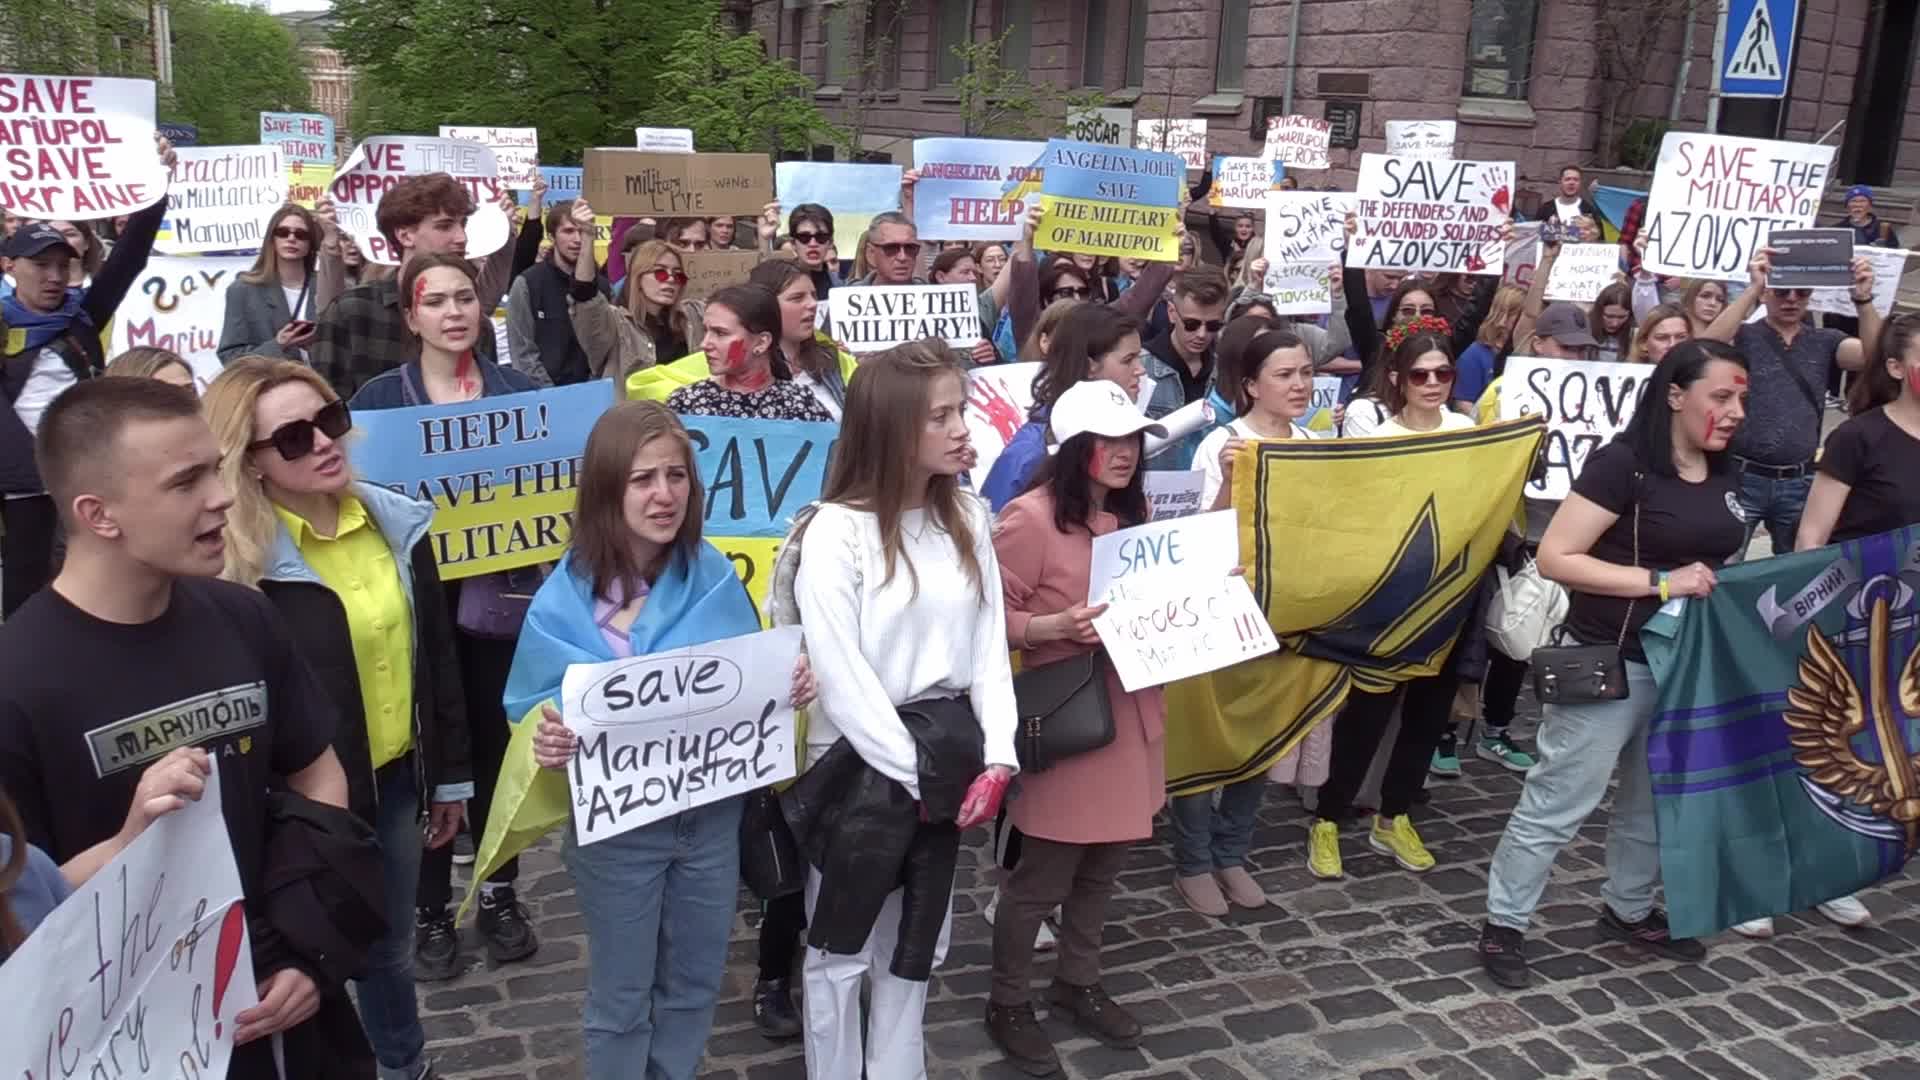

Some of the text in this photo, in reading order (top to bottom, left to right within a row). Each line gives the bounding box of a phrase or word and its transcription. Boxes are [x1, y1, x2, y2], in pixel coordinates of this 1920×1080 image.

[0, 78, 95, 113] SAVE
[300, 119, 325, 136] THE
[1076, 121, 1120, 144] OSCAR
[6, 147, 111, 181] SAVE
[362, 143, 406, 171] VE
[416, 143, 479, 173] THE
[1052, 148, 1178, 178] ANGELINA JOLIE
[1275, 146, 1328, 165] HEROES
[1677, 141, 1825, 188] SAVE THE
[921, 162, 1044, 182] ANGELINA JOLI
[1380, 159, 1476, 203] SAVE
[1095, 181, 1138, 199] SAVE
[1214, 186, 1268, 199] MARIUPO
[1688, 179, 1820, 216] MILITARY OF
[949, 198, 1024, 226] HELP
[1053, 202, 1169, 228] THE MILITARY
[1280, 196, 1332, 238] SAVE
[1360, 200, 1488, 222] THE DEFENDERS AND
[176, 217, 264, 245] Mariupol
[1051, 227, 1163, 254] OF MARIUPOL
[1355, 238, 1367, 247] OF
[1364, 219, 1502, 241] WOUNDED SOLDIERS
[142, 270, 228, 312] Sav
[847, 290, 972, 316] SAVE THE
[127, 317, 217, 352] Mariu
[837, 316, 980, 343] MILITARY!!
[418, 404, 552, 456] HEPL!
[1112, 530, 1185, 579] SAVE
[1794, 565, 1847, 617] ВІРНИЙ
[603, 660, 725, 711] save
[586, 740, 777, 832] Azovstal
